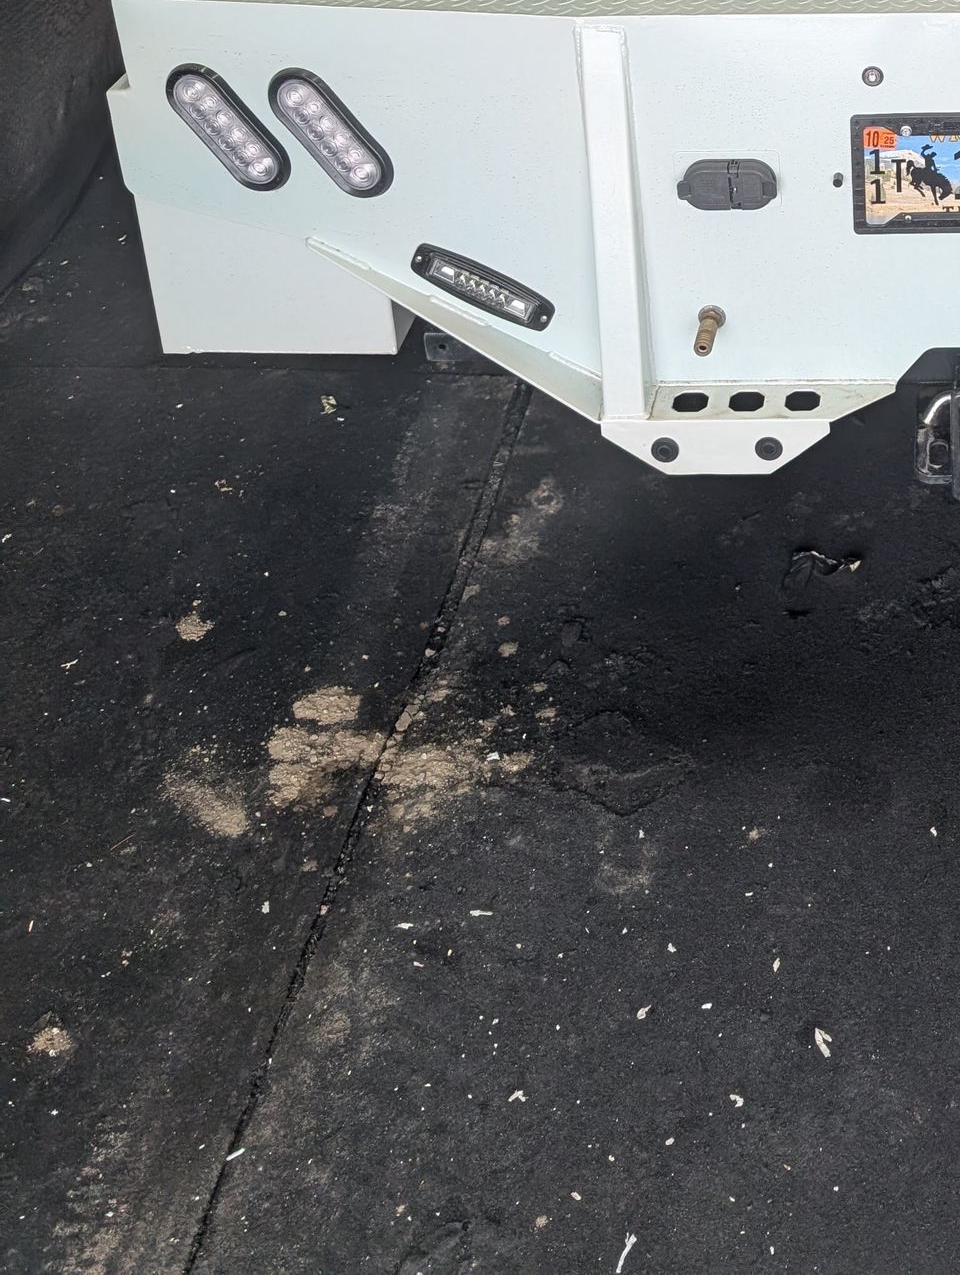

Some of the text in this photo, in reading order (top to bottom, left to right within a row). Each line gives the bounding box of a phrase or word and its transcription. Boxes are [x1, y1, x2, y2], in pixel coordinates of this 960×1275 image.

[866, 131, 894, 147] 10 25
[891, 159, 906, 193] T
